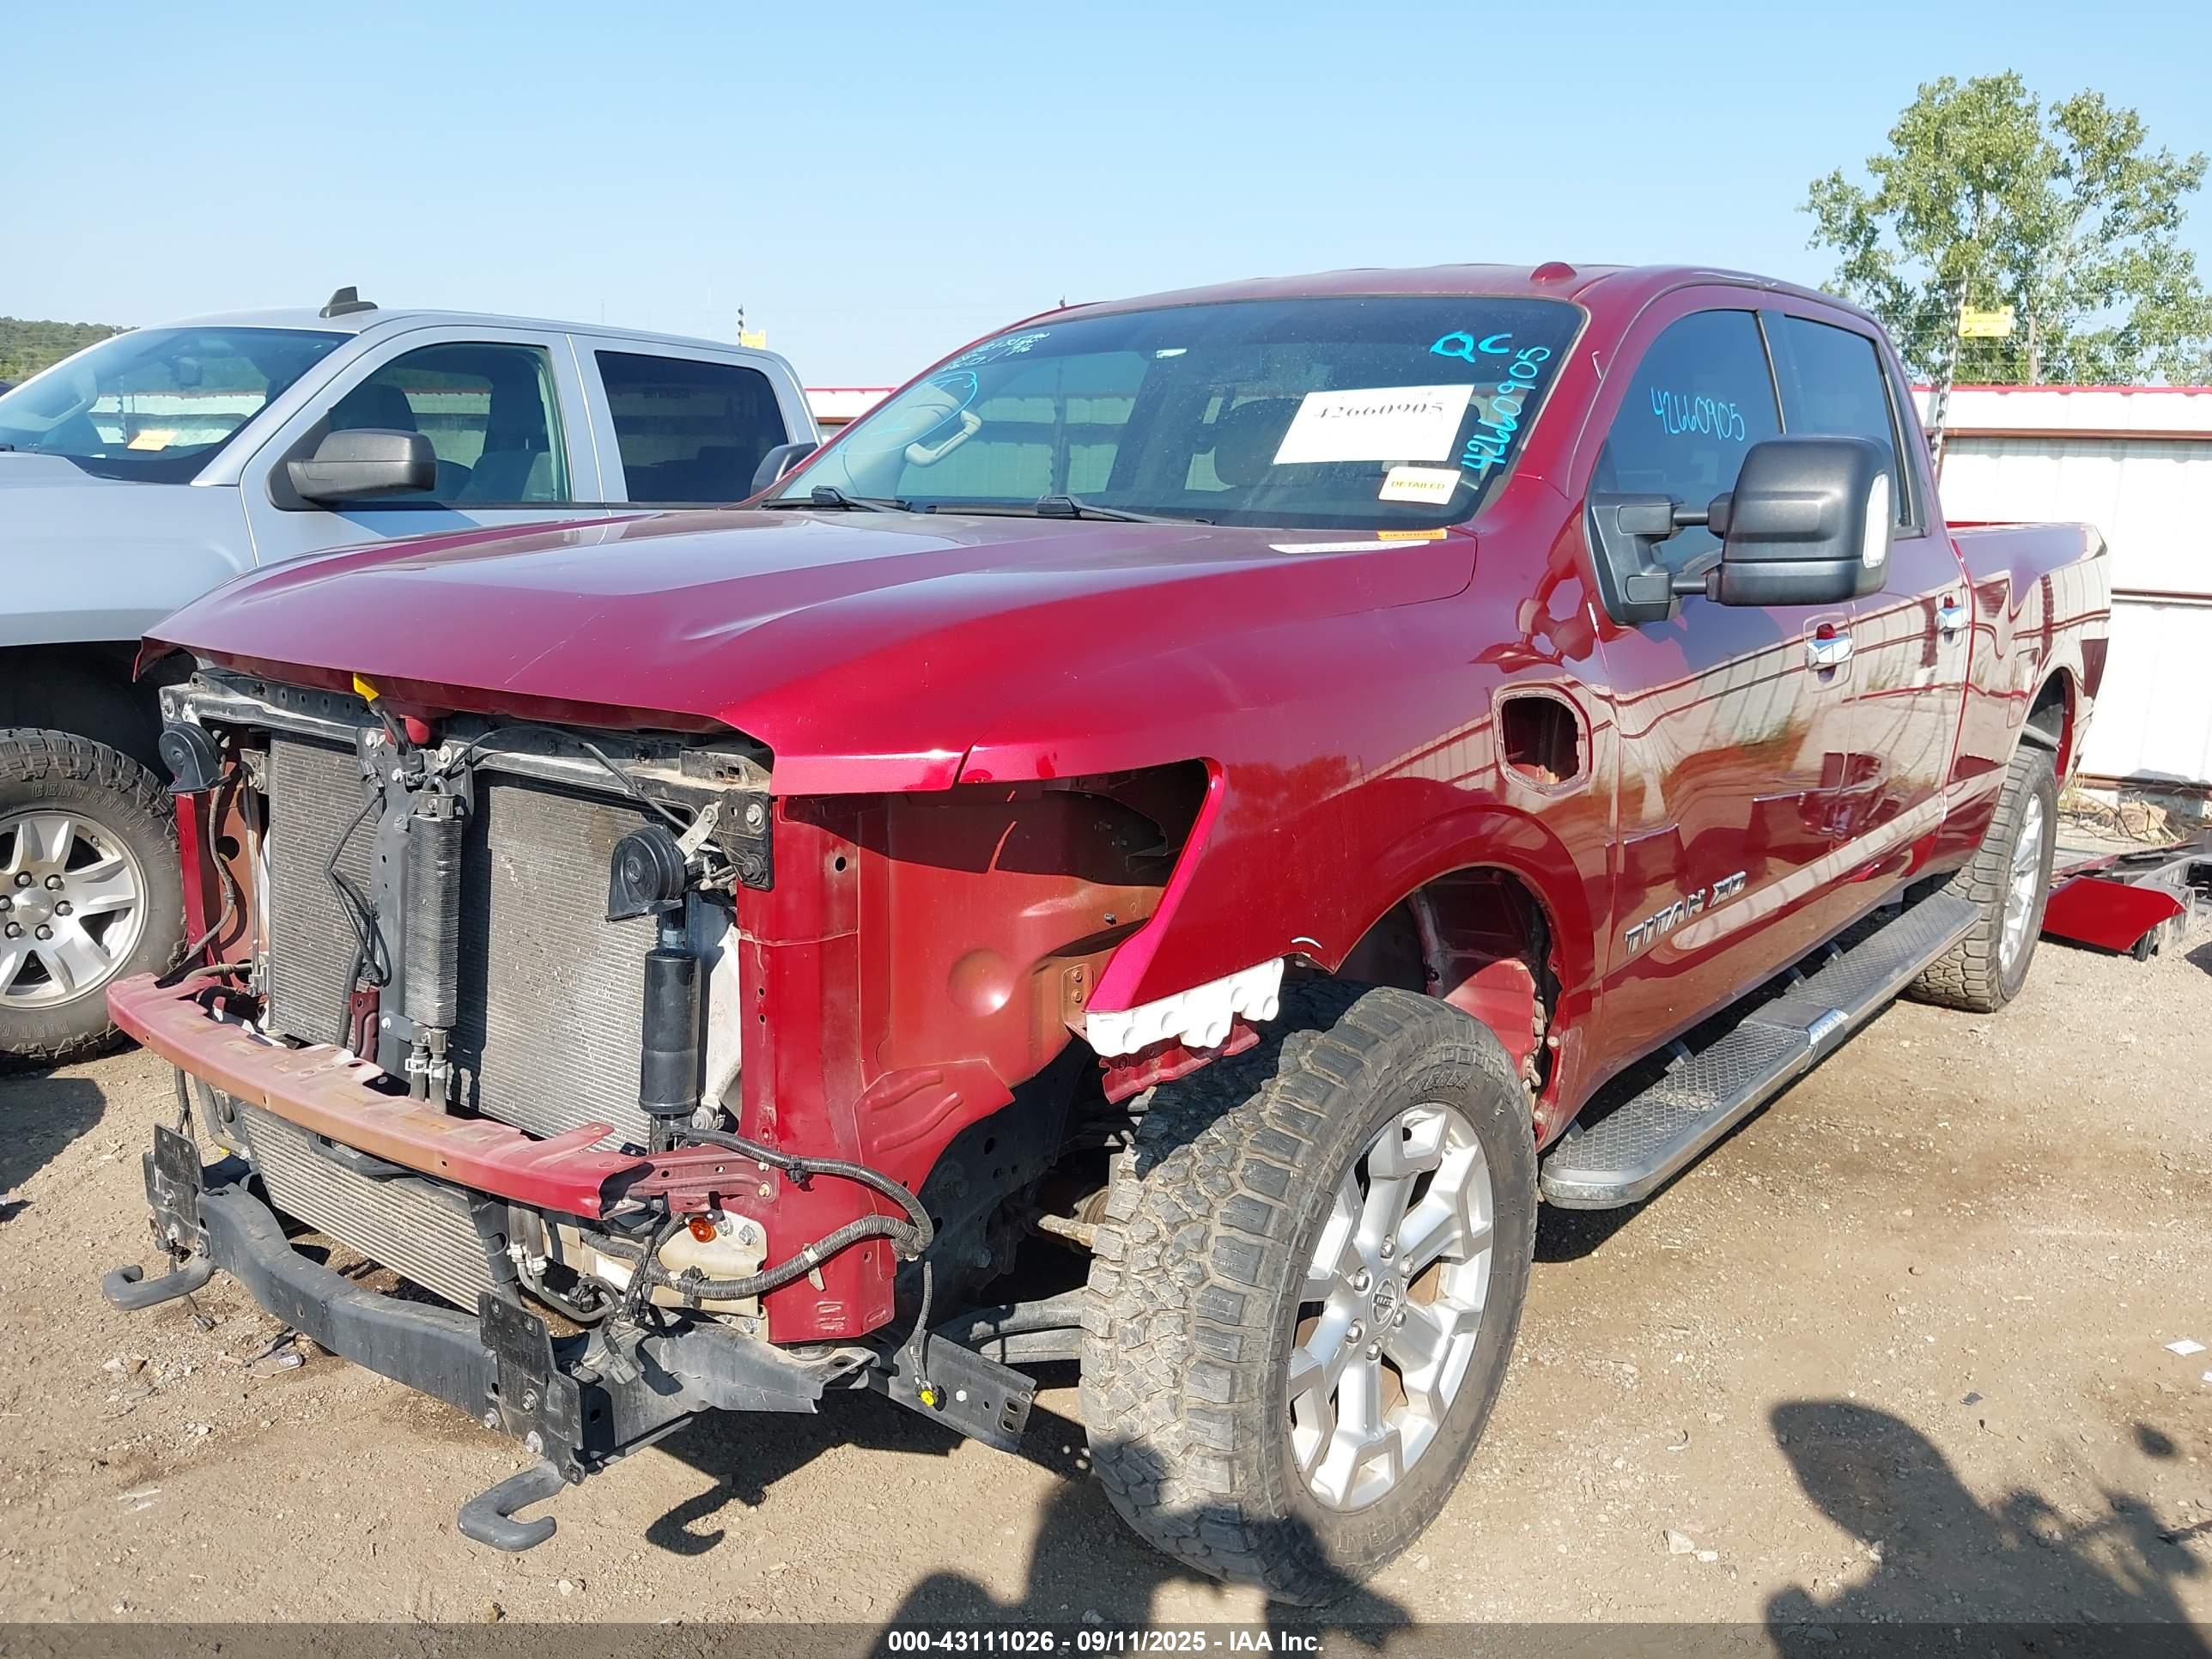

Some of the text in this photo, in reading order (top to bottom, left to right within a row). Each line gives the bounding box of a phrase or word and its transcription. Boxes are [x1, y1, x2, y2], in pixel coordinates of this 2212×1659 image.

[1429, 330, 1512, 363] QC
[1461, 346, 1551, 469] 42660905
[1650, 386, 1745, 441] 42660905
[1390, 480, 1446, 490] DETAILED
[31, 781, 154, 839] CENTENNIAL
[1624, 870, 1747, 956] TITAN XD
